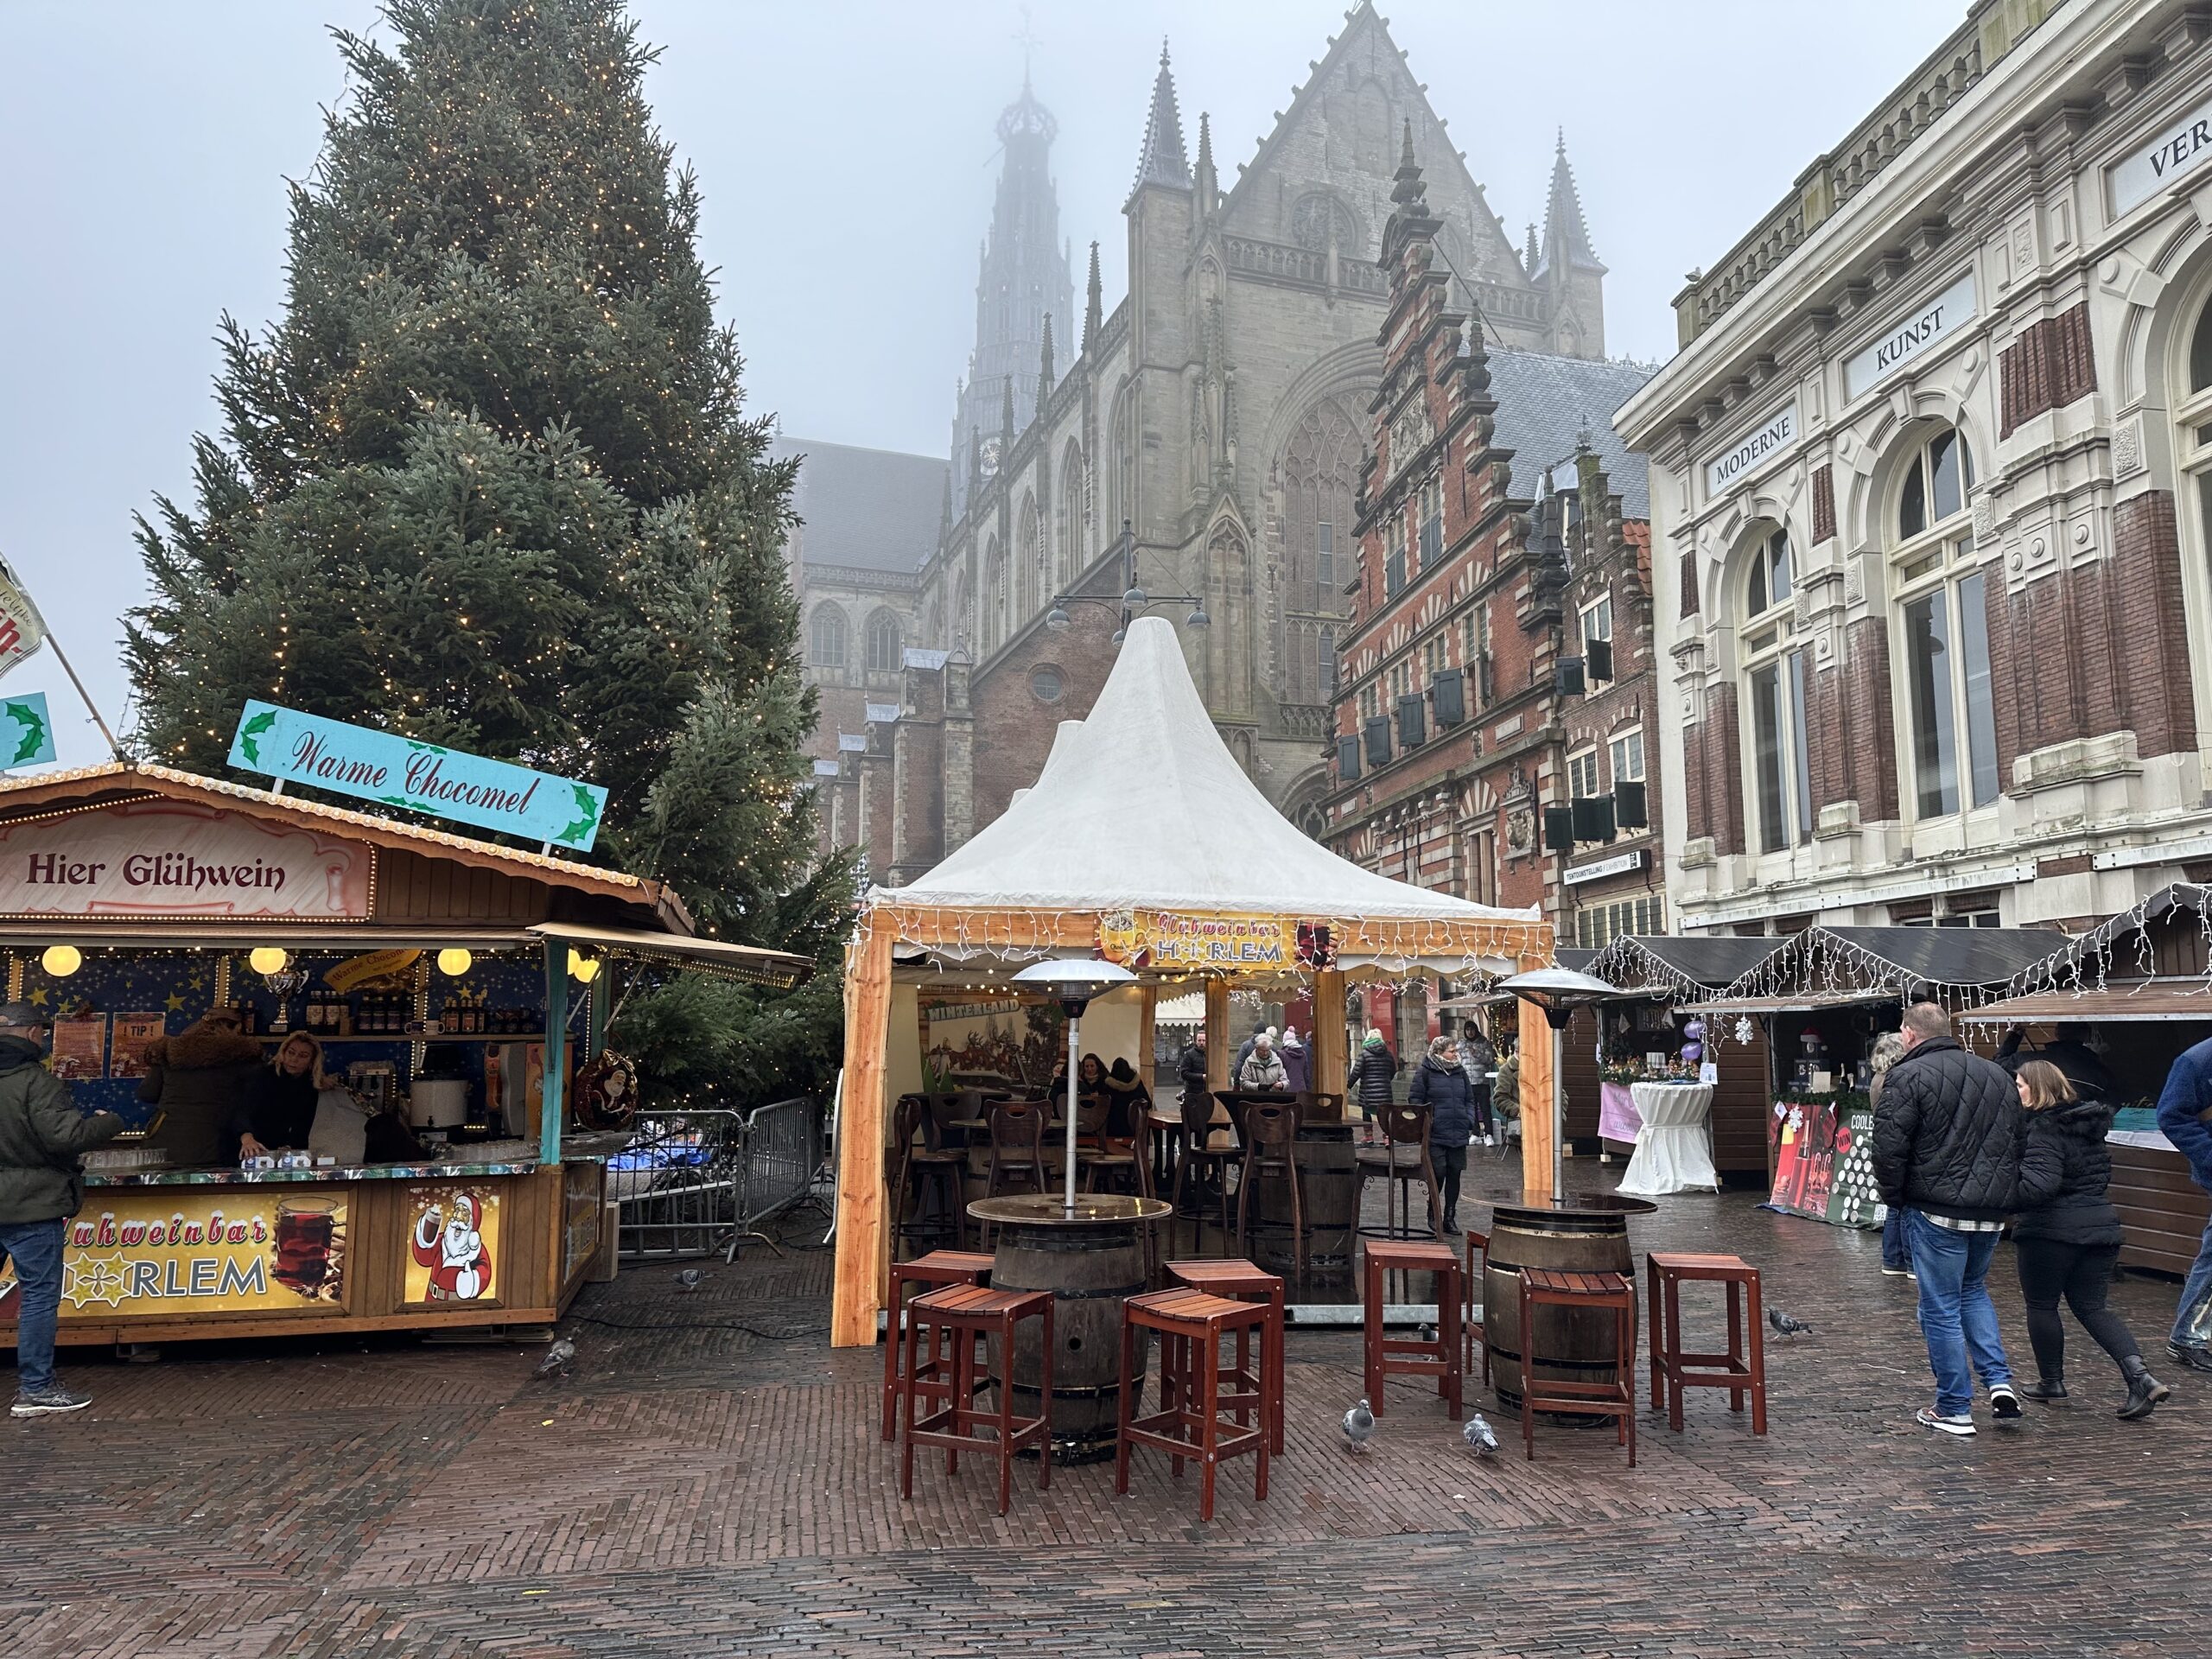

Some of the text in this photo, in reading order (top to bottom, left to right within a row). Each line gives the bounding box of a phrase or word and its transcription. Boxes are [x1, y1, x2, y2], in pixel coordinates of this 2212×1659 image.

[2150, 119, 2212, 177] VER
[1877, 304, 1944, 372] KUNST
[1717, 416, 1790, 484] MODERNE
[291, 731, 541, 815] Warme Chocomel
[26, 852, 286, 893] Hier Glühwein
[131, 1026, 147, 1037] TIP
[929, 999, 1020, 1021] WINTERLAND
[1838, 1133, 1851, 1147] WIN
